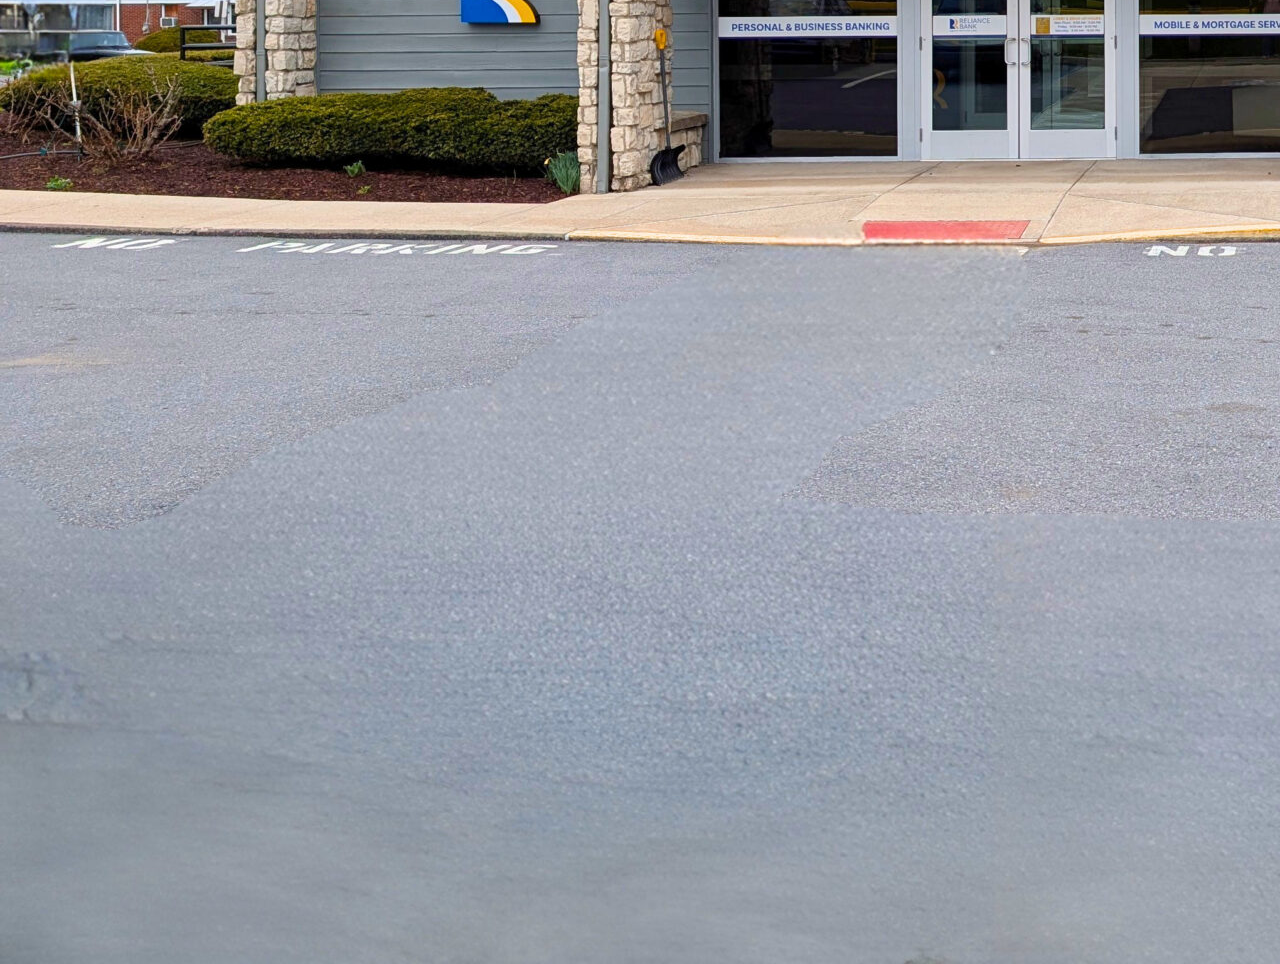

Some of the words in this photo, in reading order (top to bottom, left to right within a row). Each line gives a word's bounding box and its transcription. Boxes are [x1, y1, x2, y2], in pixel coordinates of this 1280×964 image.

[731, 23, 784, 32] PERSONAL
[785, 23, 792, 32] &
[794, 22, 843, 32] BUSINESS
[845, 22, 890, 32] BANKING
[1153, 20, 1191, 29] MOBILE
[1192, 20, 1200, 29] &
[1202, 20, 1256, 29] MORTGAGE
[51, 237, 179, 251] NO
[235, 239, 560, 256] PARKING
[1143, 244, 1240, 258] NO
